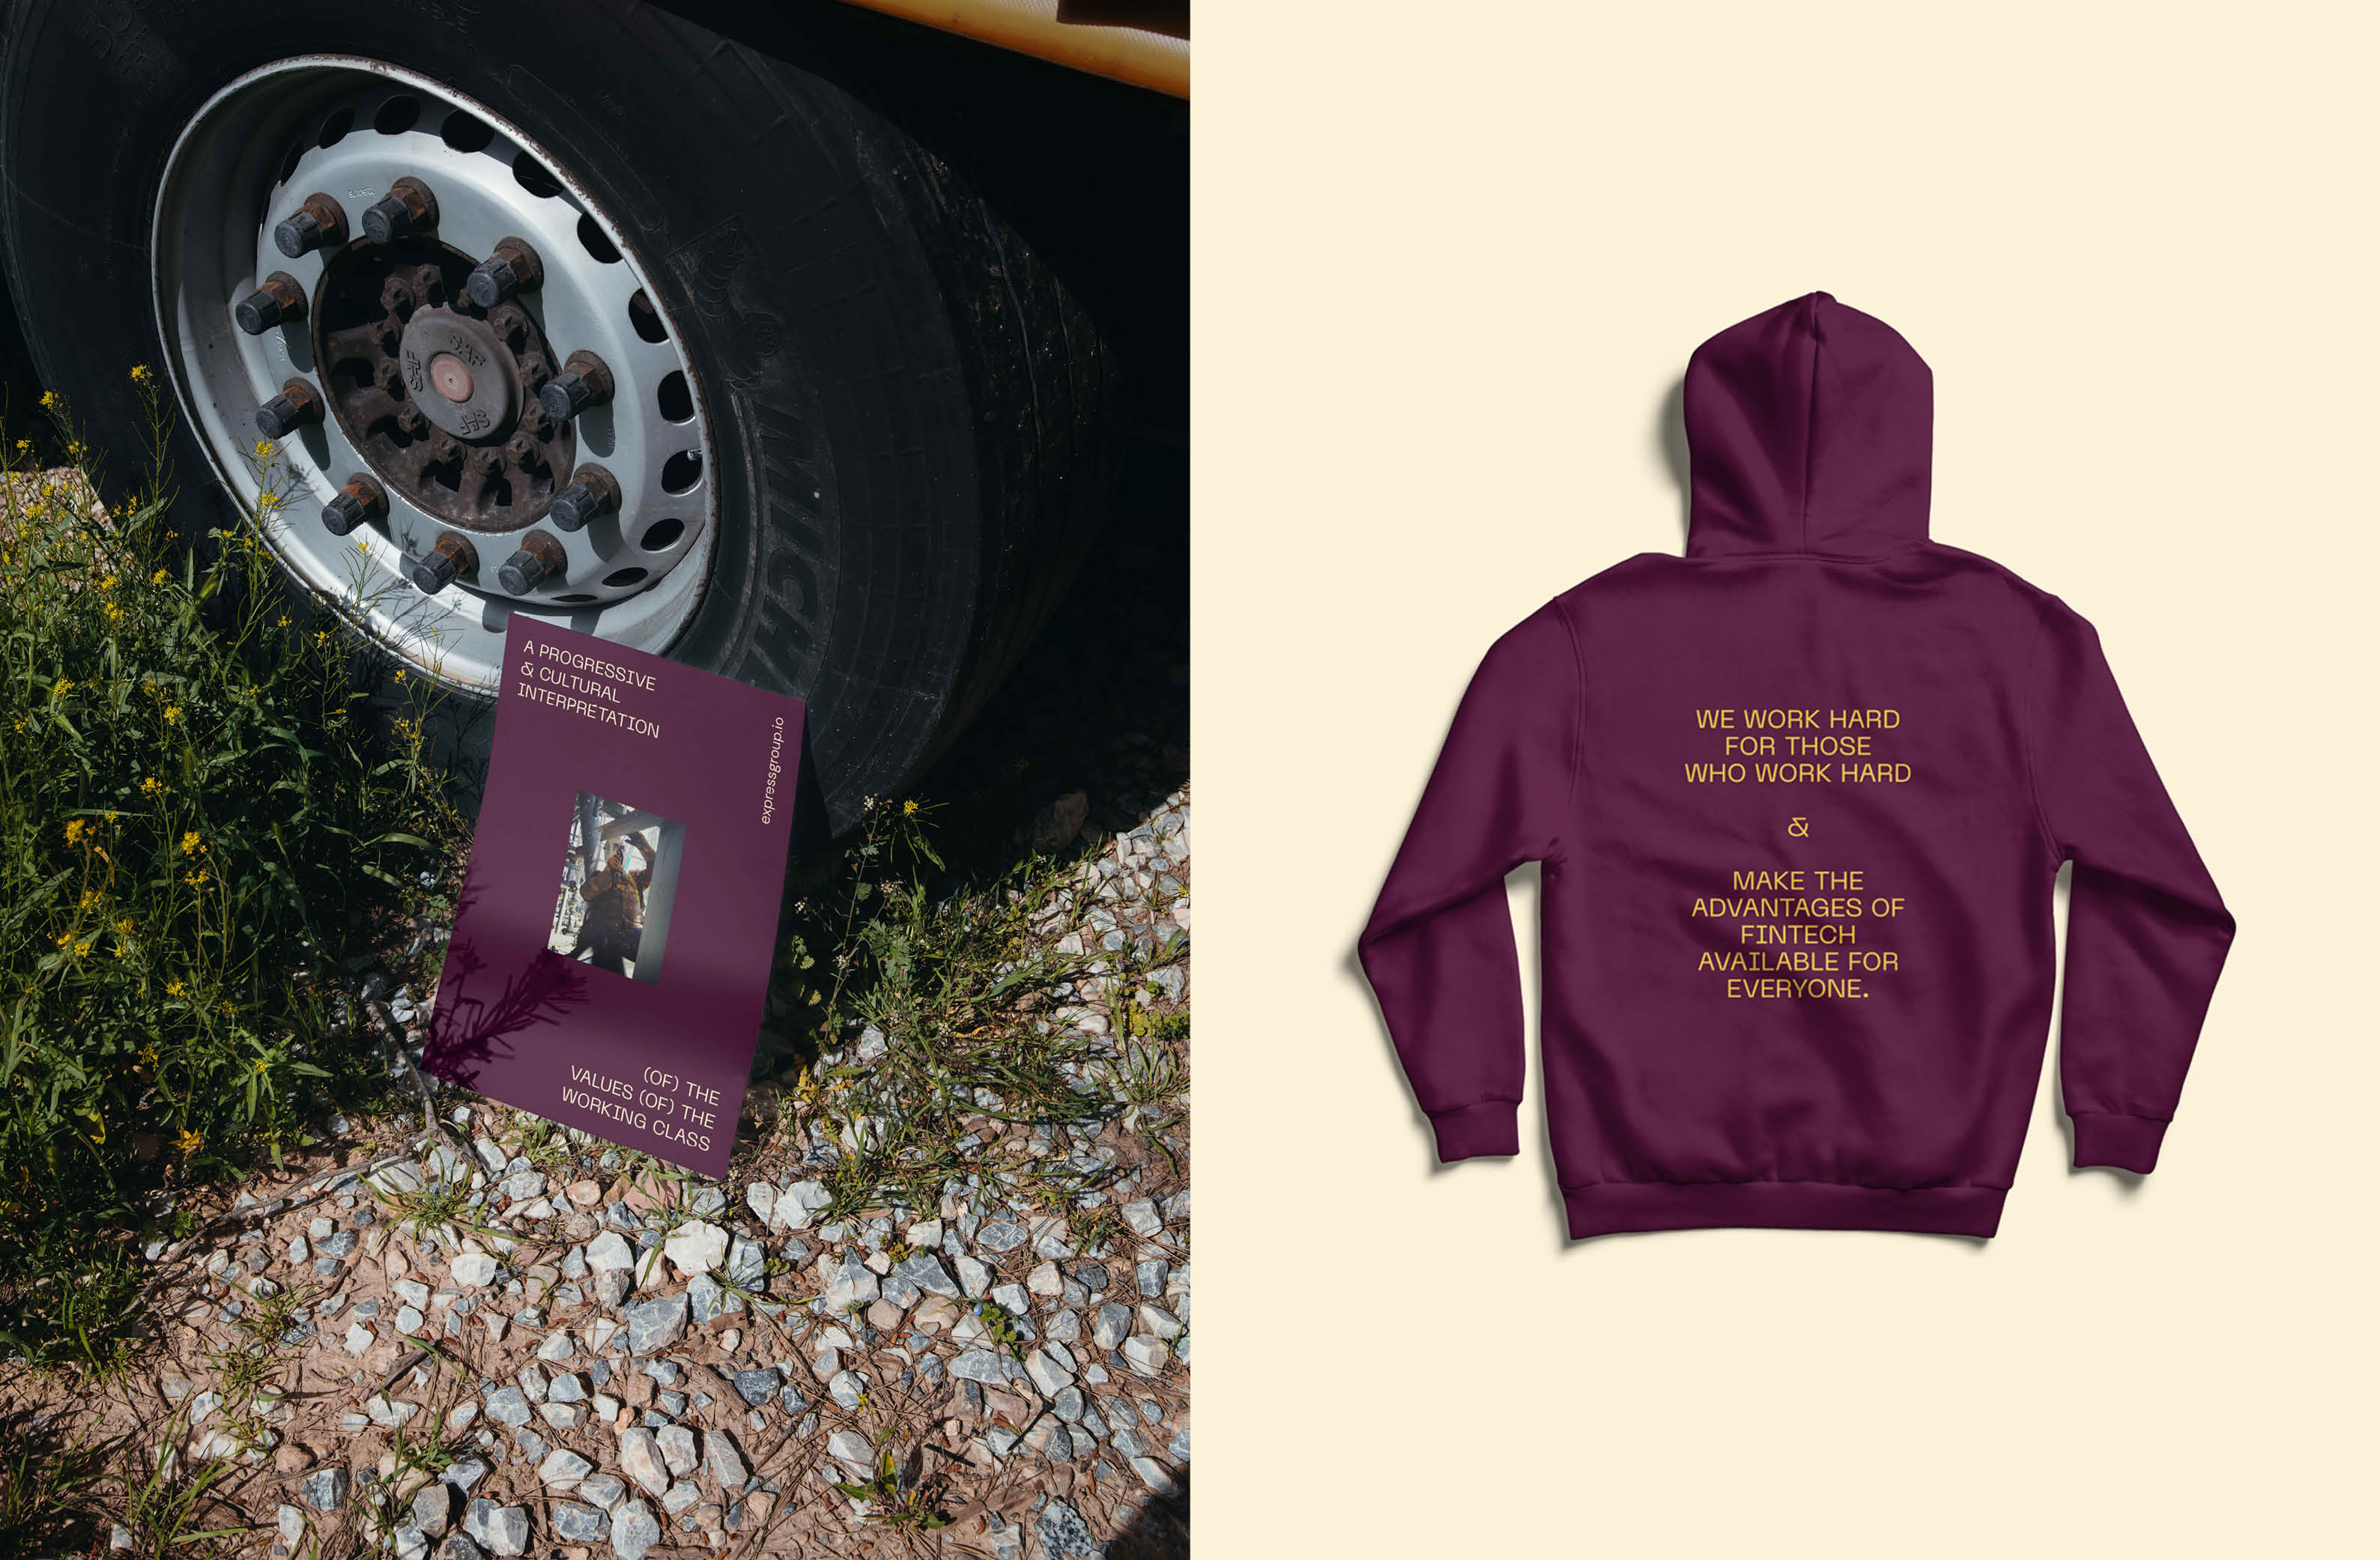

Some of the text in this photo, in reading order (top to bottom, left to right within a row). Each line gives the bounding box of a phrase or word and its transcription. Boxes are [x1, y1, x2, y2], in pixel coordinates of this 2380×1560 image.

[449, 335, 487, 367] SAF
[459, 410, 491, 436] SAF
[751, 399, 827, 683] MICH
[523, 640, 657, 691] A PROGRESSIVE
[521, 661, 621, 704] & CULTURAL
[517, 682, 660, 738] INTERPRETATION
[1696, 708, 1901, 729] WE WORK HARD
[1725, 735, 1871, 756] FOR THOSE
[761, 716, 785, 825] expressgroup.io
[1684, 762, 1912, 783] WHO WORK HARD
[1787, 816, 1809, 838] &
[1733, 871, 1864, 890] MAKE THE
[1692, 897, 1905, 917] ADVANTAGES OF
[1741, 924, 1856, 944] FINTECH
[1698, 951, 1898, 971] AVAILABLE FOR
[1728, 978, 1869, 998] EVERYONE.
[571, 1064, 716, 1129] VALUES (OF) THE
[644, 1066, 721, 1107] (OF) THE
[563, 1086, 710, 1151] WORKING CLASS
